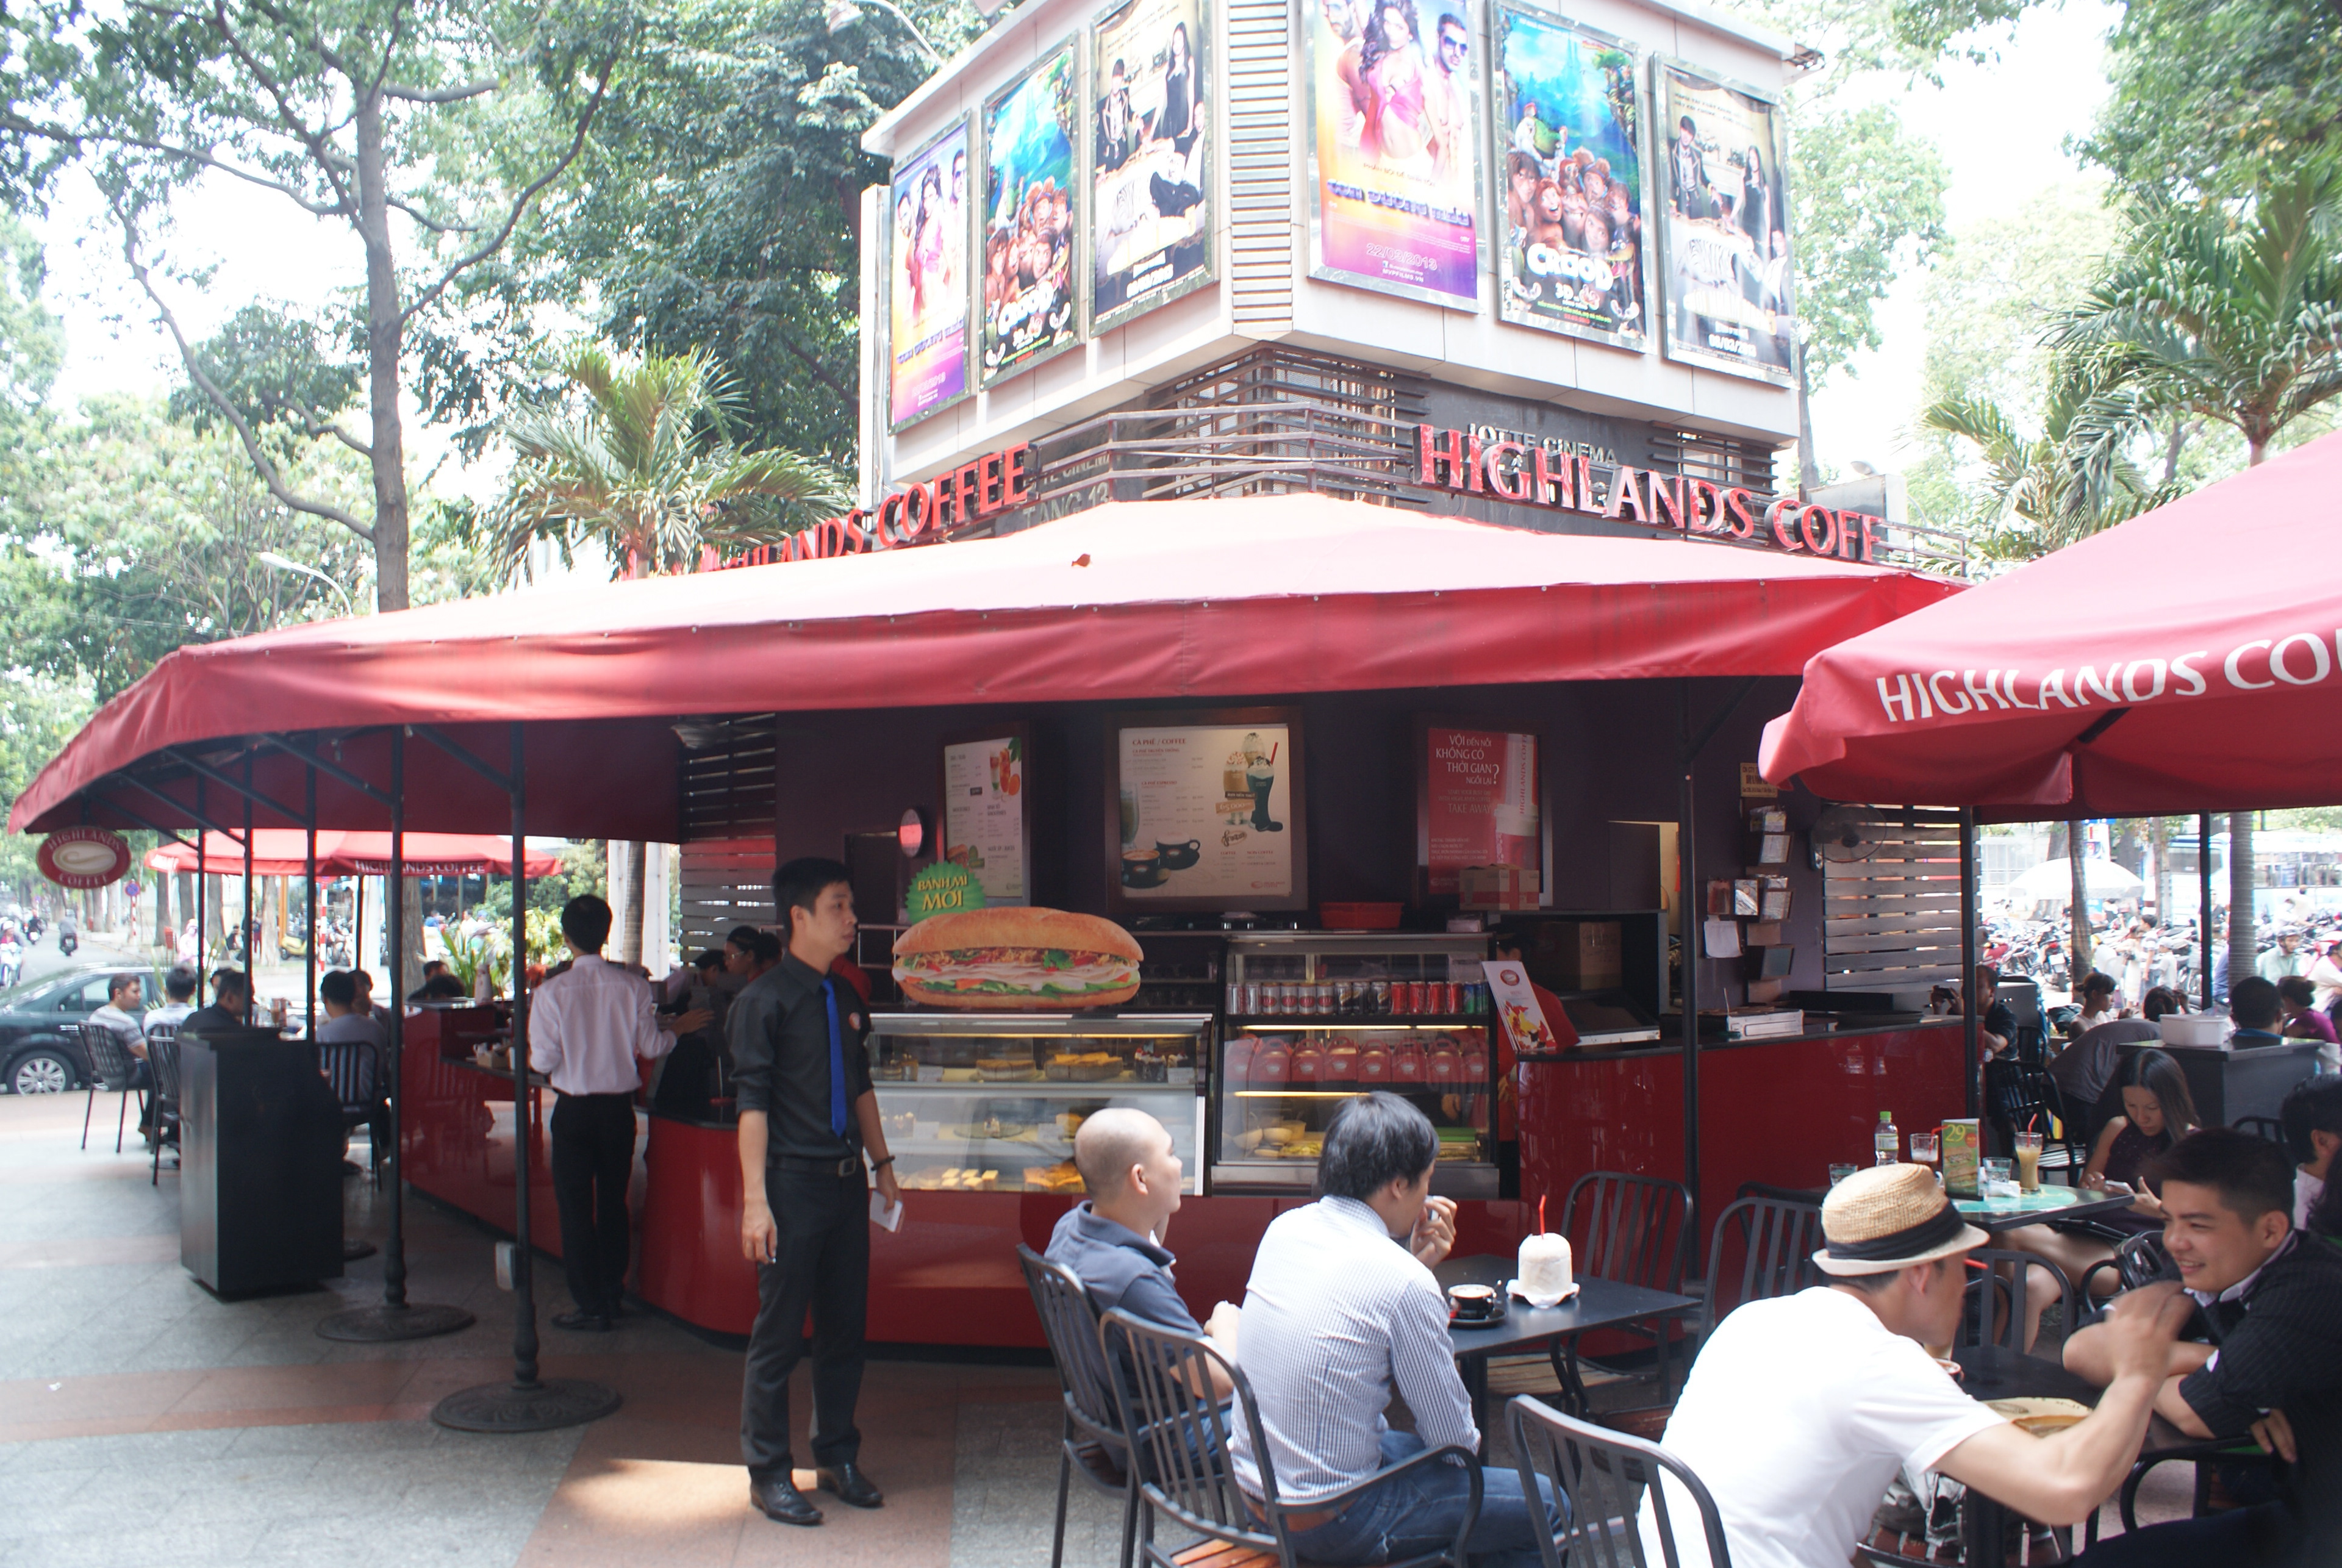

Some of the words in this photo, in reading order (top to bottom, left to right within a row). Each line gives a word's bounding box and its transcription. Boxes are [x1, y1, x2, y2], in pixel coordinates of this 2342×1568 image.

[1366, 243, 1438, 270] 22/03/2013
[1555, 282, 1574, 301] 3D
[1541, 435, 1619, 464] CINEMA
[878, 440, 1028, 546] COFFEE
[1412, 423, 1754, 539] HIGHLANDS
[1767, 499, 1884, 562] COFF
[1875, 650, 2208, 722] HIGHLANDS
[1449, 734, 1465, 747] VỘI
[1436, 746, 1470, 760] KHÔNG
[1471, 747, 1484, 760] CÓ
[1447, 761, 1469, 773] THỜI
[1470, 762, 1492, 774] GIAN
[1492, 764, 1500, 785] ?
[1449, 803, 1467, 814] TAKE
[1470, 803, 1491, 814] AWAY
[47, 829, 120, 851] HIGHLANDS
[354, 859, 435, 874] HIGHNDS
[435, 862, 485, 874] COFFEE
[59, 873, 107, 887] COFFEE
[917, 876, 950, 891] BÁNH
[922, 886, 963, 911] MỚI
[1945, 1123, 1966, 1142] 29
